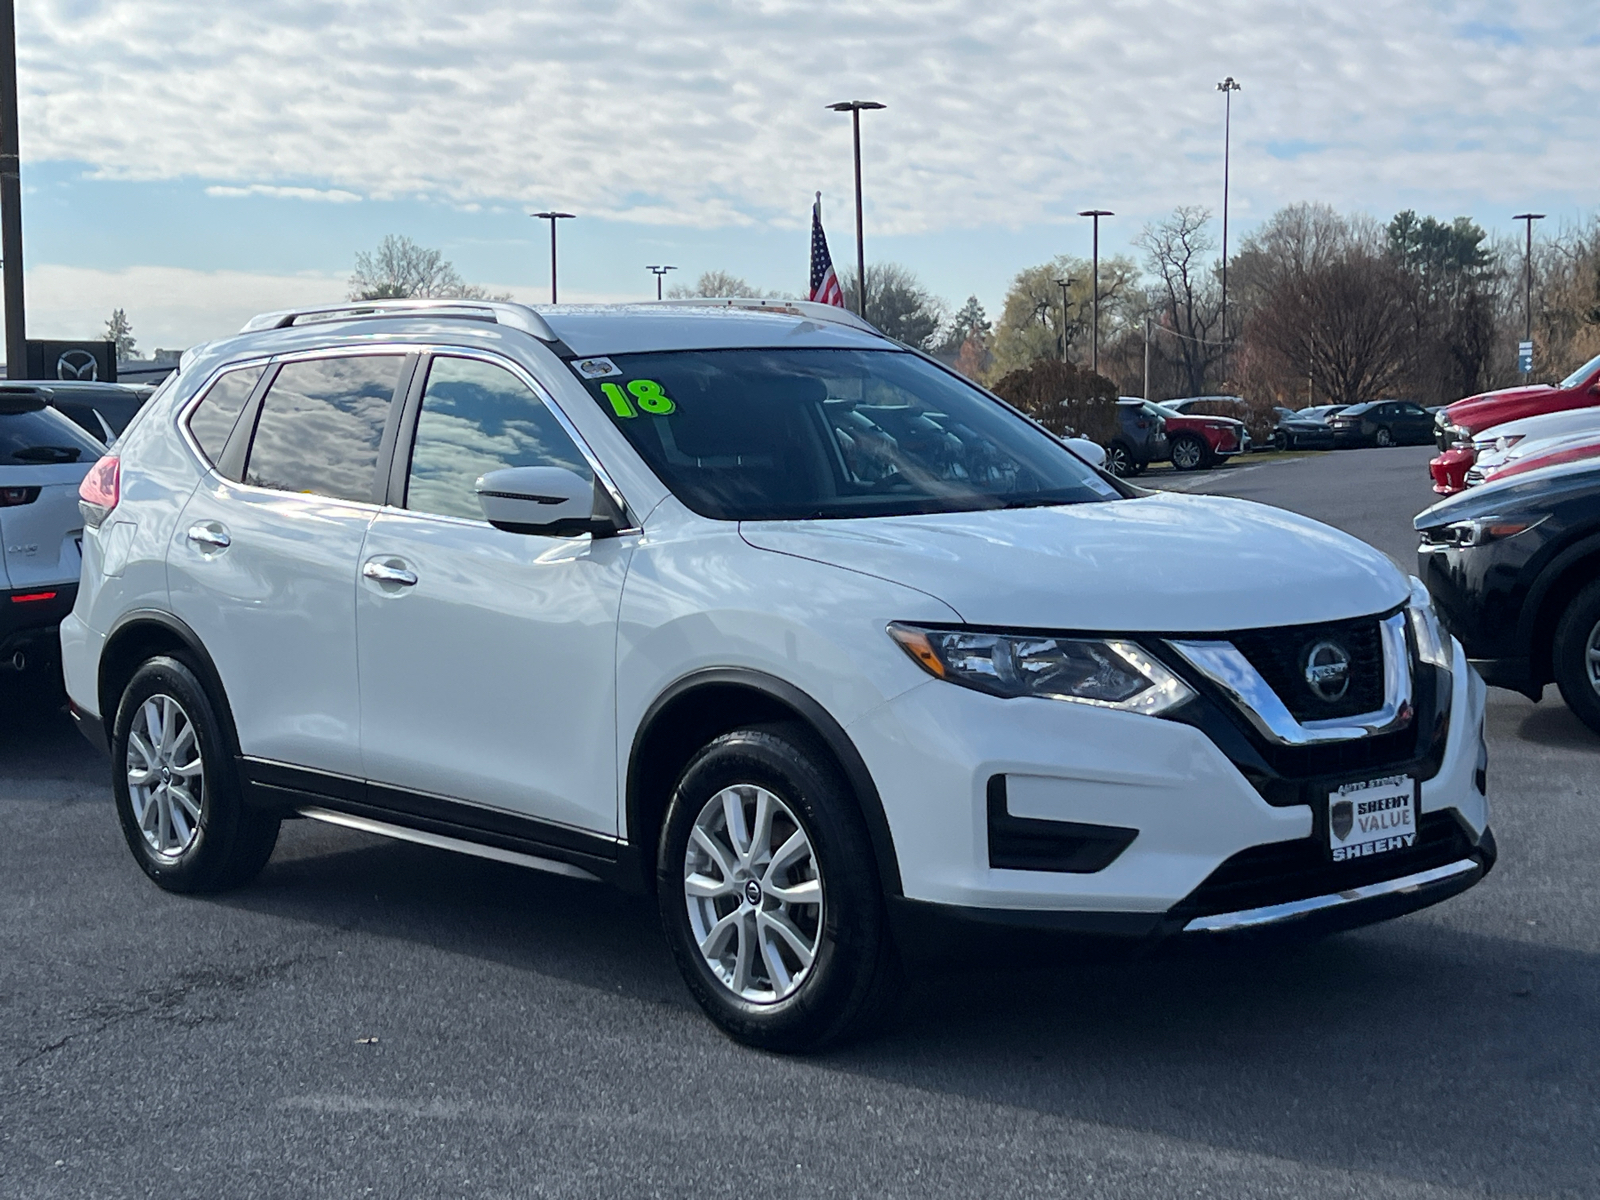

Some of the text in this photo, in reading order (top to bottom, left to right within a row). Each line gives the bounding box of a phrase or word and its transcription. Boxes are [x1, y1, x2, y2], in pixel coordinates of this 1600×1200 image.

[601, 379, 676, 418] 18
[1358, 794, 1410, 815] SHEEHY
[1358, 809, 1411, 833] VALUE
[1333, 834, 1416, 861] SHEEHY
